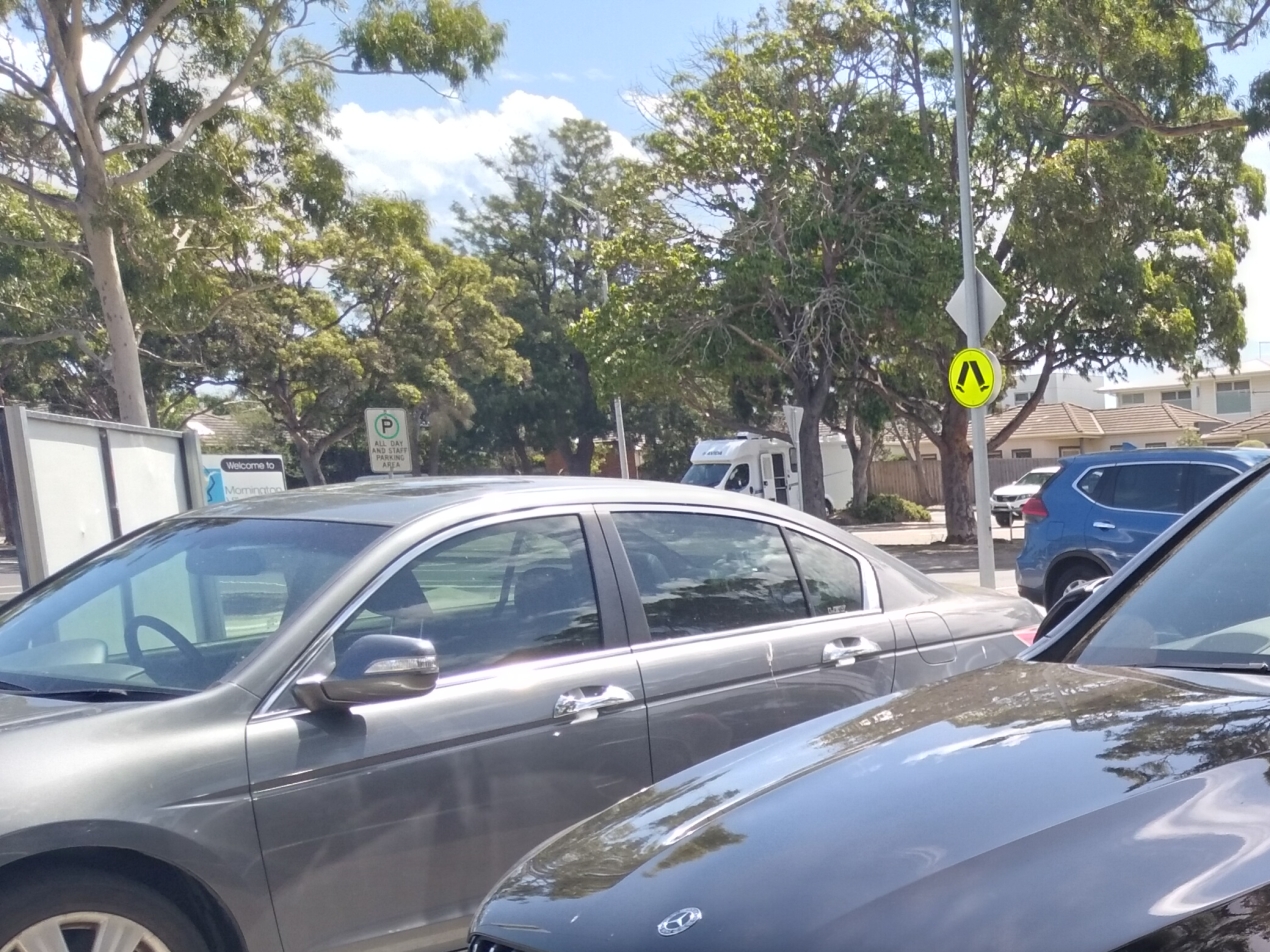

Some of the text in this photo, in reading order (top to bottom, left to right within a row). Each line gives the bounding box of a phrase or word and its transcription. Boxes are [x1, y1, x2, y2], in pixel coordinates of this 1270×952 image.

[381, 418, 393, 434] P
[225, 461, 275, 470] Welcome to
[225, 485, 283, 495] Mornington
